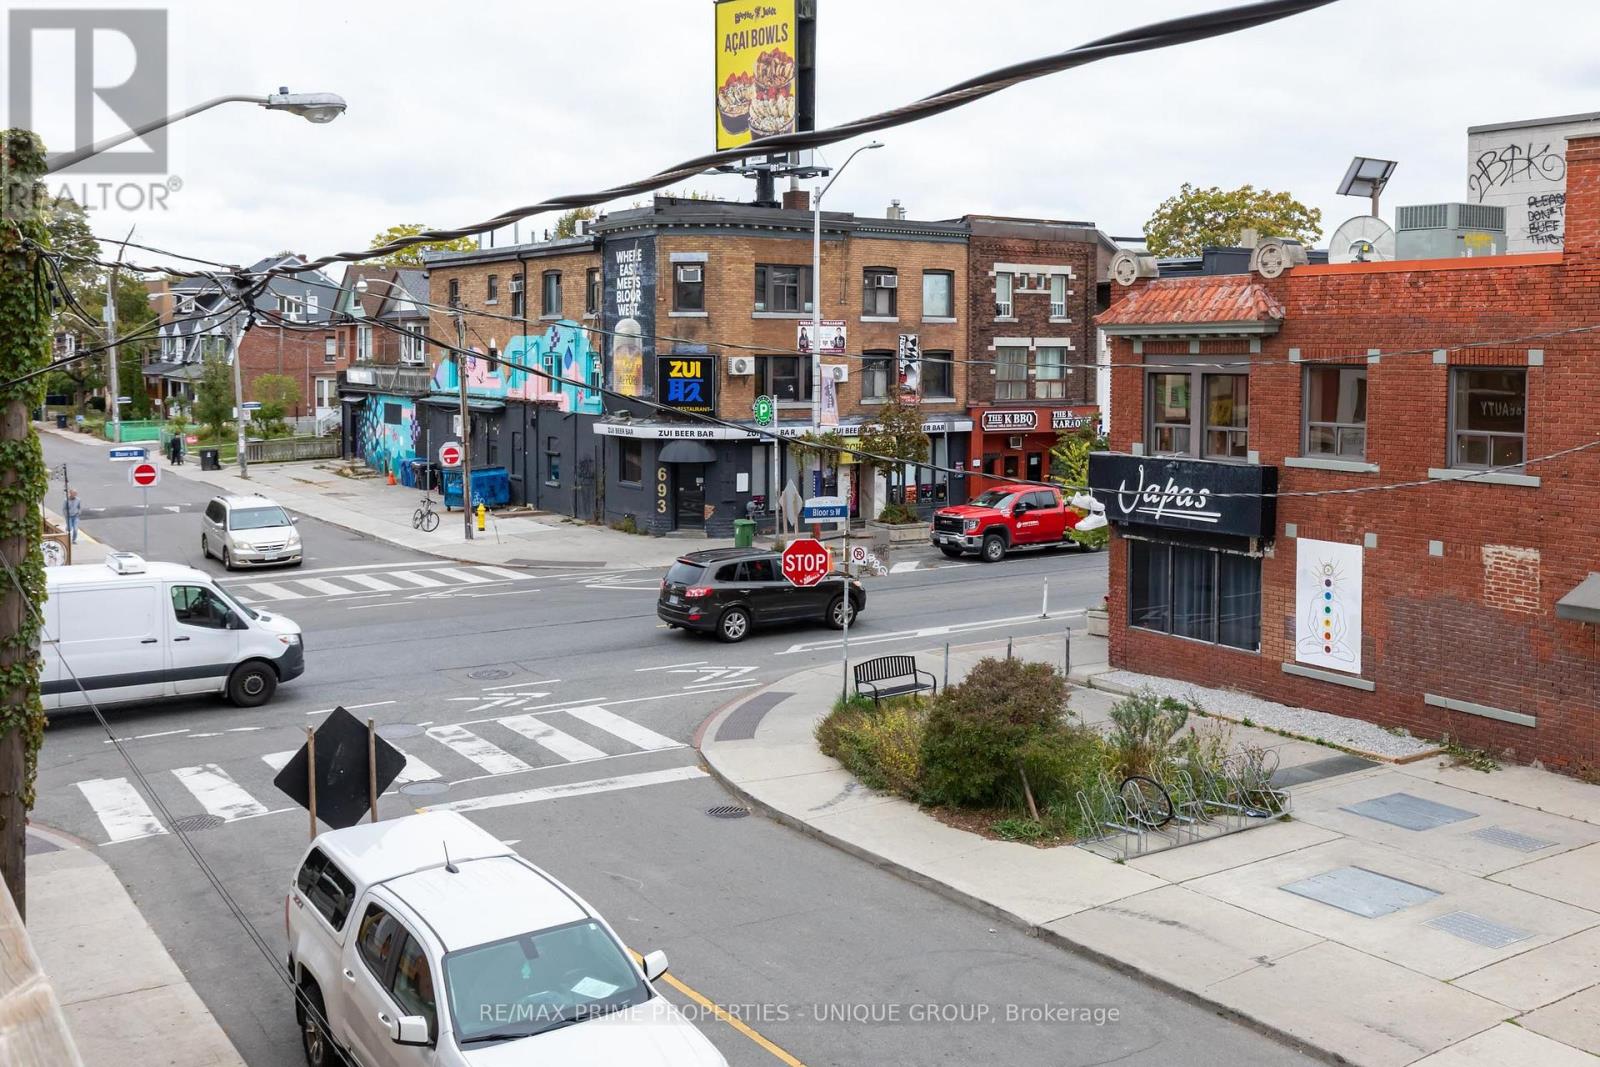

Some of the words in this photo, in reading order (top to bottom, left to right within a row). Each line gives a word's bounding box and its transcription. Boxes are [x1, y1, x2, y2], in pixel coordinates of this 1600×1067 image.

[725, 30, 749, 56] AÇAI
[751, 23, 788, 48] BOWLS
[616, 289, 641, 303] BLOOR
[669, 360, 701, 378] ZUI
[988, 414, 1003, 423] THE
[1005, 414, 1012, 424] K
[1013, 413, 1033, 425] BBQ
[615, 427, 625, 435] BEER
[697, 430, 714, 438] BAR
[1117, 464, 1211, 520] Japas
[812, 508, 829, 517] Bloor
[835, 508, 841, 516] W
[785, 554, 826, 572] STOP
